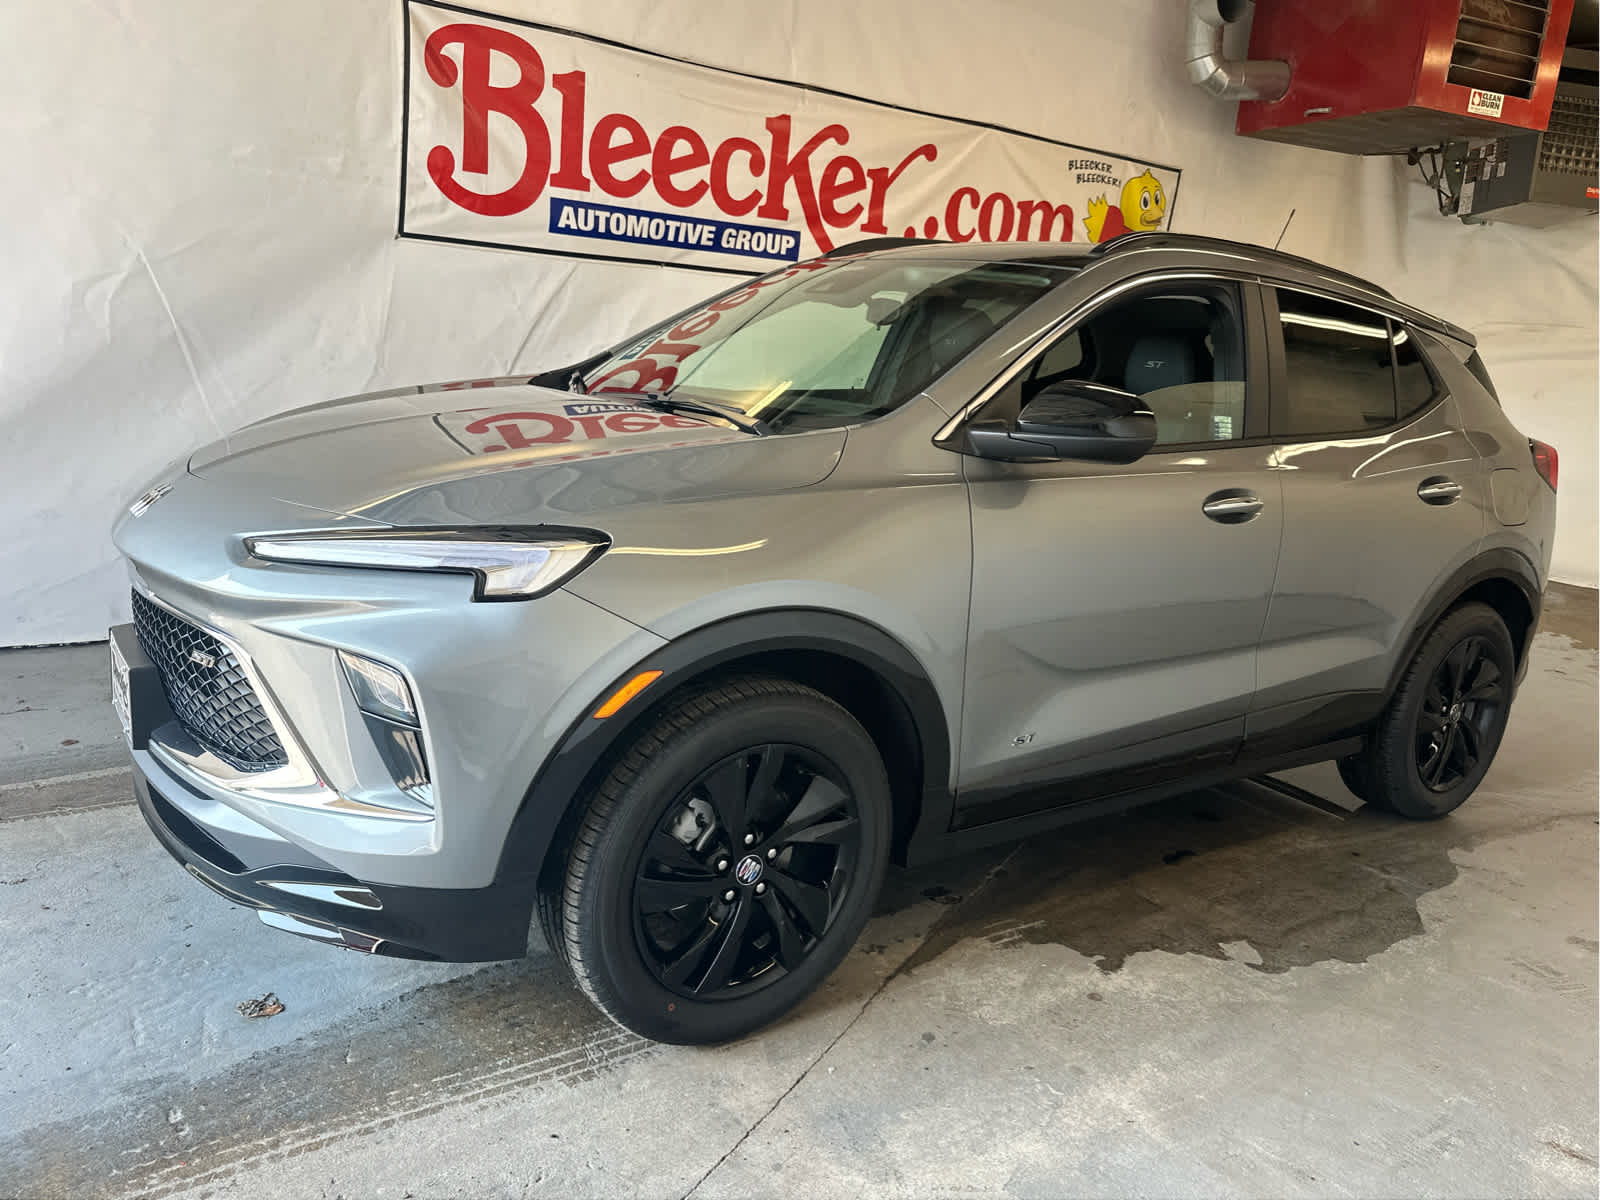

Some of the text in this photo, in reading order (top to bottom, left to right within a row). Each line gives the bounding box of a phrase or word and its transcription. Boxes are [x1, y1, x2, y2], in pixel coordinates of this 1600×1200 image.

[1482, 93, 1502, 103] CLEAN
[1480, 99, 1500, 110] BURN
[1068, 159, 1112, 174] BLEECKER
[557, 205, 795, 256] AUTOMOTIVE GROUP
[1144, 360, 1165, 369] ST
